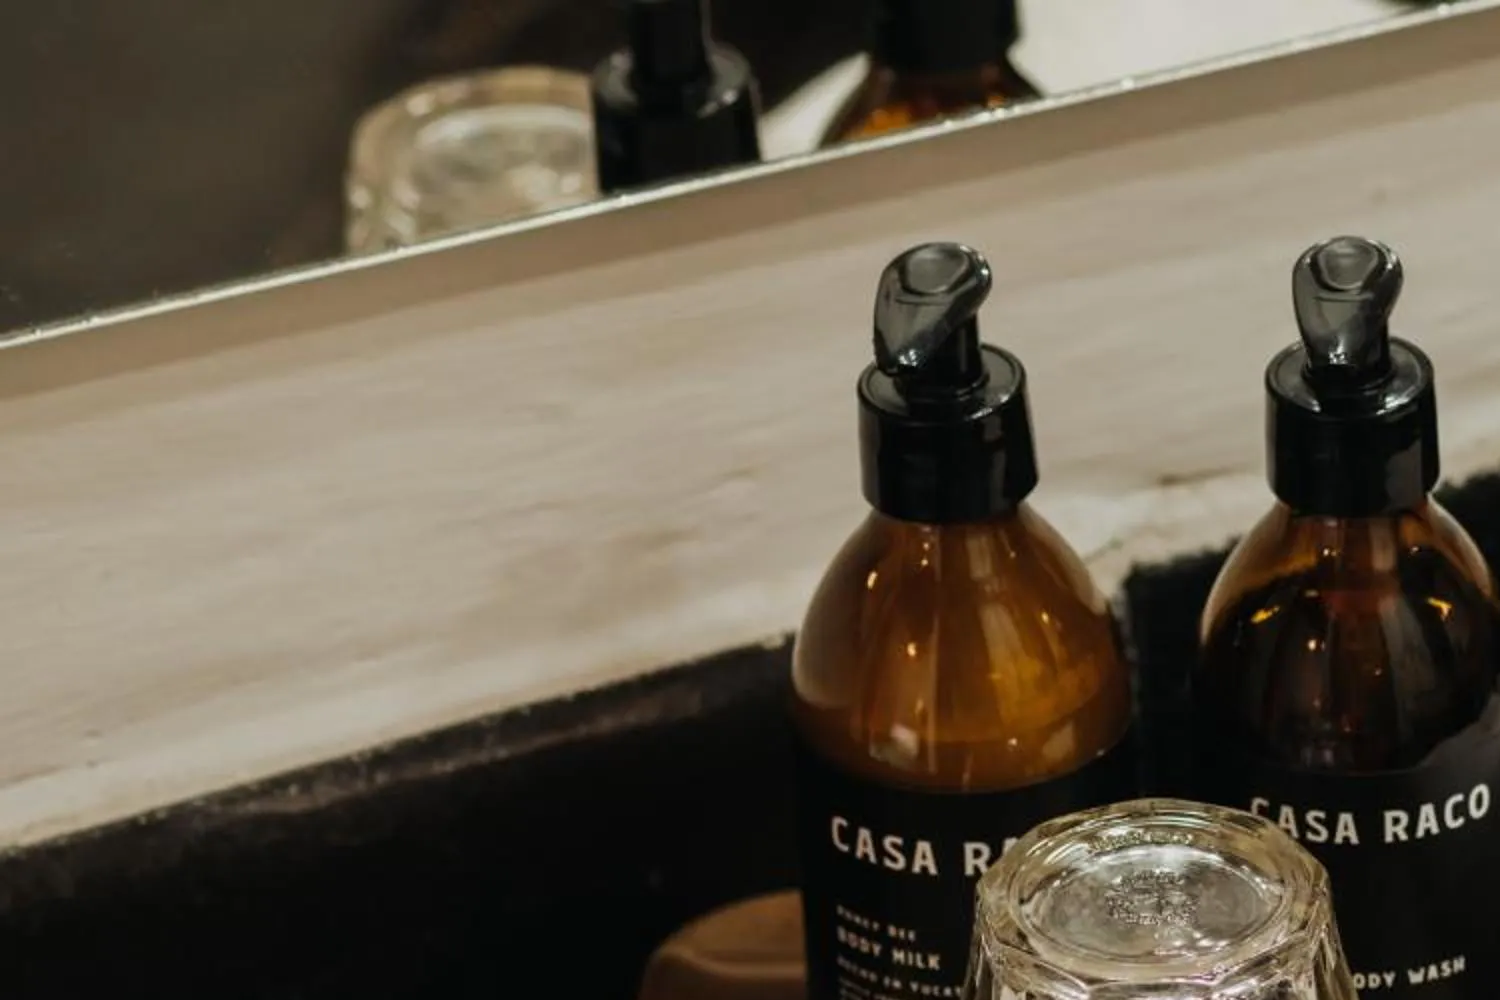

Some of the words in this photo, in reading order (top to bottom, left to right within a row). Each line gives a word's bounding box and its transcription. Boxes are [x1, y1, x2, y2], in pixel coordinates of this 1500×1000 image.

[1248, 796, 1360, 845] CASA
[1383, 783, 1490, 845] RACO
[831, 815, 938, 877] CASA
[836, 924, 882, 957] BODY
[891, 946, 941, 971] MILK
[909, 980, 962, 997] YUCAT
[1352, 970, 1396, 990] ODY
[1406, 954, 1466, 986] WASH
